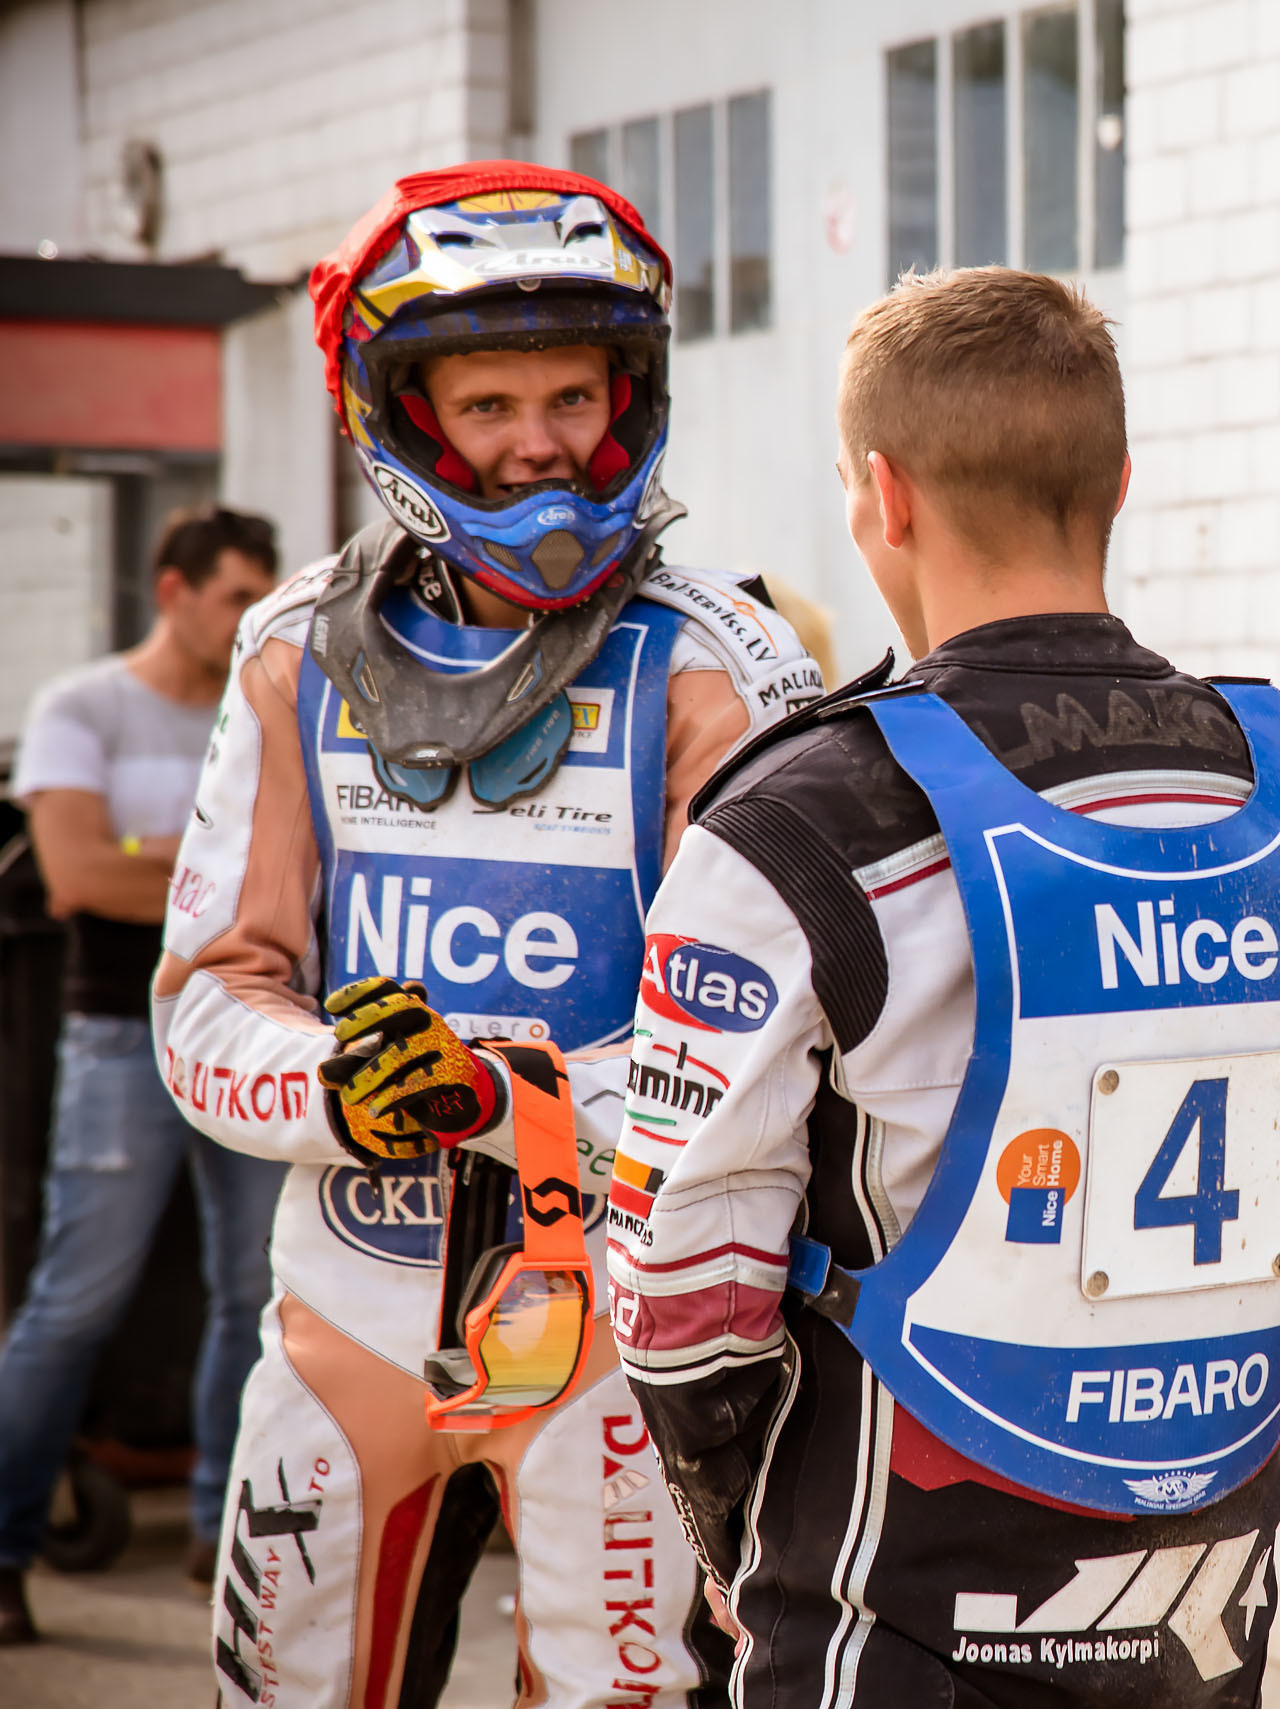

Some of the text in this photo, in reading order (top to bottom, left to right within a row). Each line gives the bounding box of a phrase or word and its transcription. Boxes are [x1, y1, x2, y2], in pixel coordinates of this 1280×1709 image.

[382, 478, 439, 529] Arai
[360, 817, 437, 830] INTELLIGENCE
[556, 805, 613, 823] Tire
[346, 873, 579, 989] Nice
[1094, 900, 1280, 990] Nice
[642, 942, 769, 1020] Atlas
[1016, 1153, 1033, 1187] Your
[1033, 1143, 1050, 1187] Smart
[1047, 1139, 1063, 1187] Home
[1133, 1076, 1240, 1268] 4
[1042, 1190, 1058, 1227] Nice
[1065, 1353, 1270, 1424] FIBARO
[260, 1547, 281, 1610] WAY
[309, 1457, 331, 1492] TO
[953, 1631, 1160, 1669] Joonas Kylmakorpi
